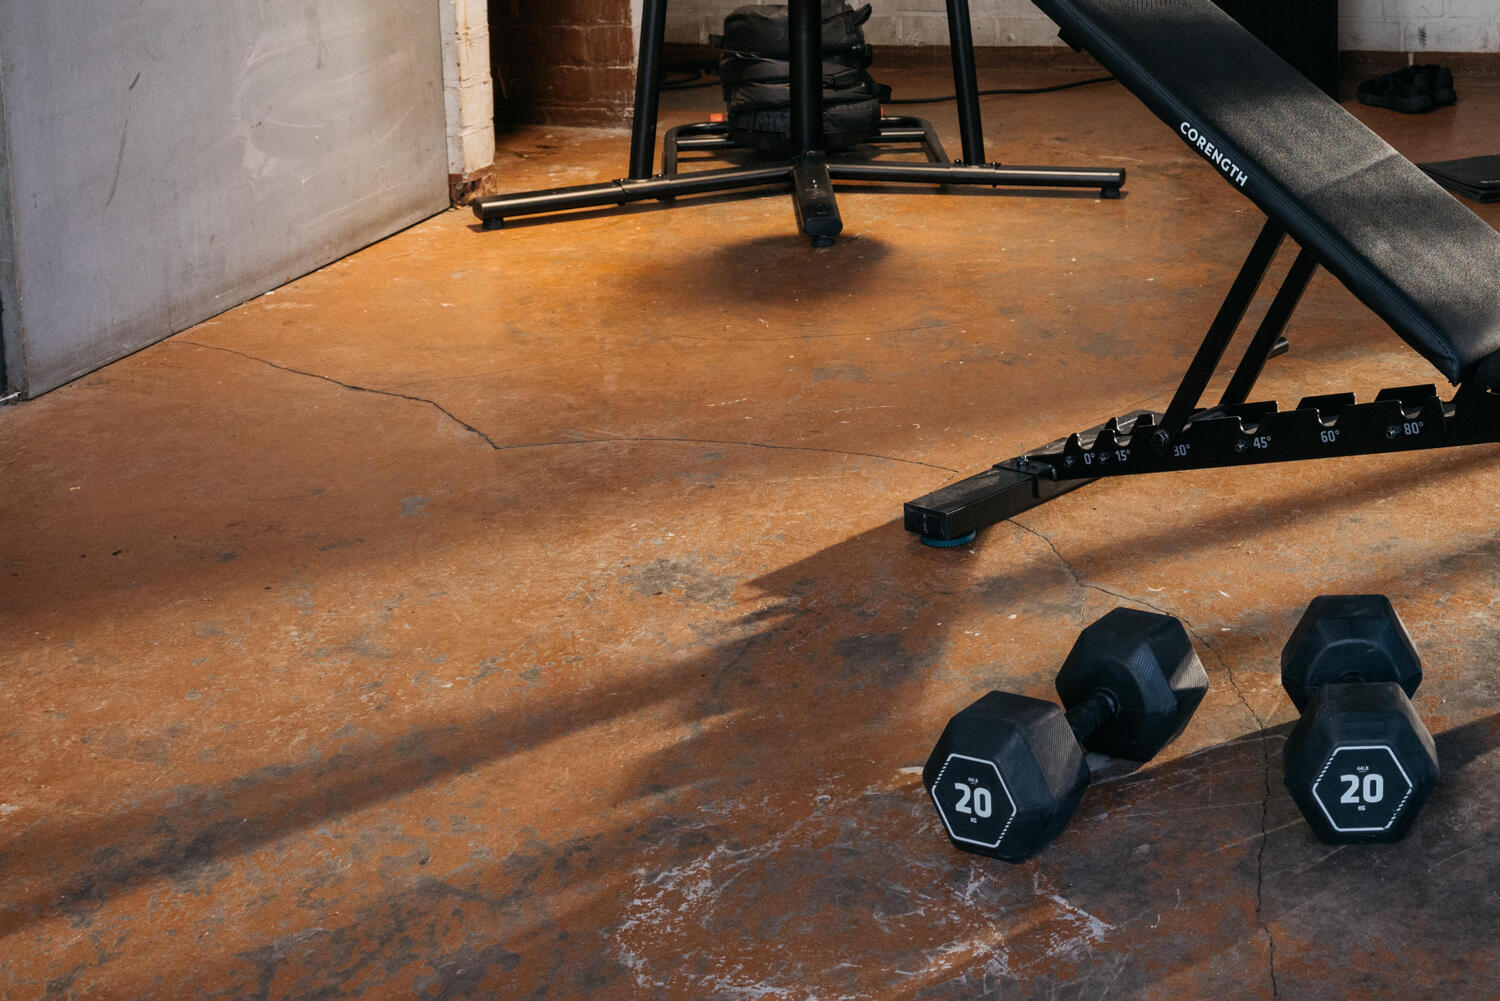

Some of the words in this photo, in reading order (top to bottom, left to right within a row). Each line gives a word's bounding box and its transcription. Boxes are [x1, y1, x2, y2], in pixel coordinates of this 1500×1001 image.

[1180, 121, 1248, 187] CORENGTH
[1320, 429, 1340, 443] 60°
[1403, 421, 1424, 436] 80°
[1253, 435, 1272, 449] 45°
[954, 782, 992, 818] 20
[1340, 773, 1384, 804] 20
